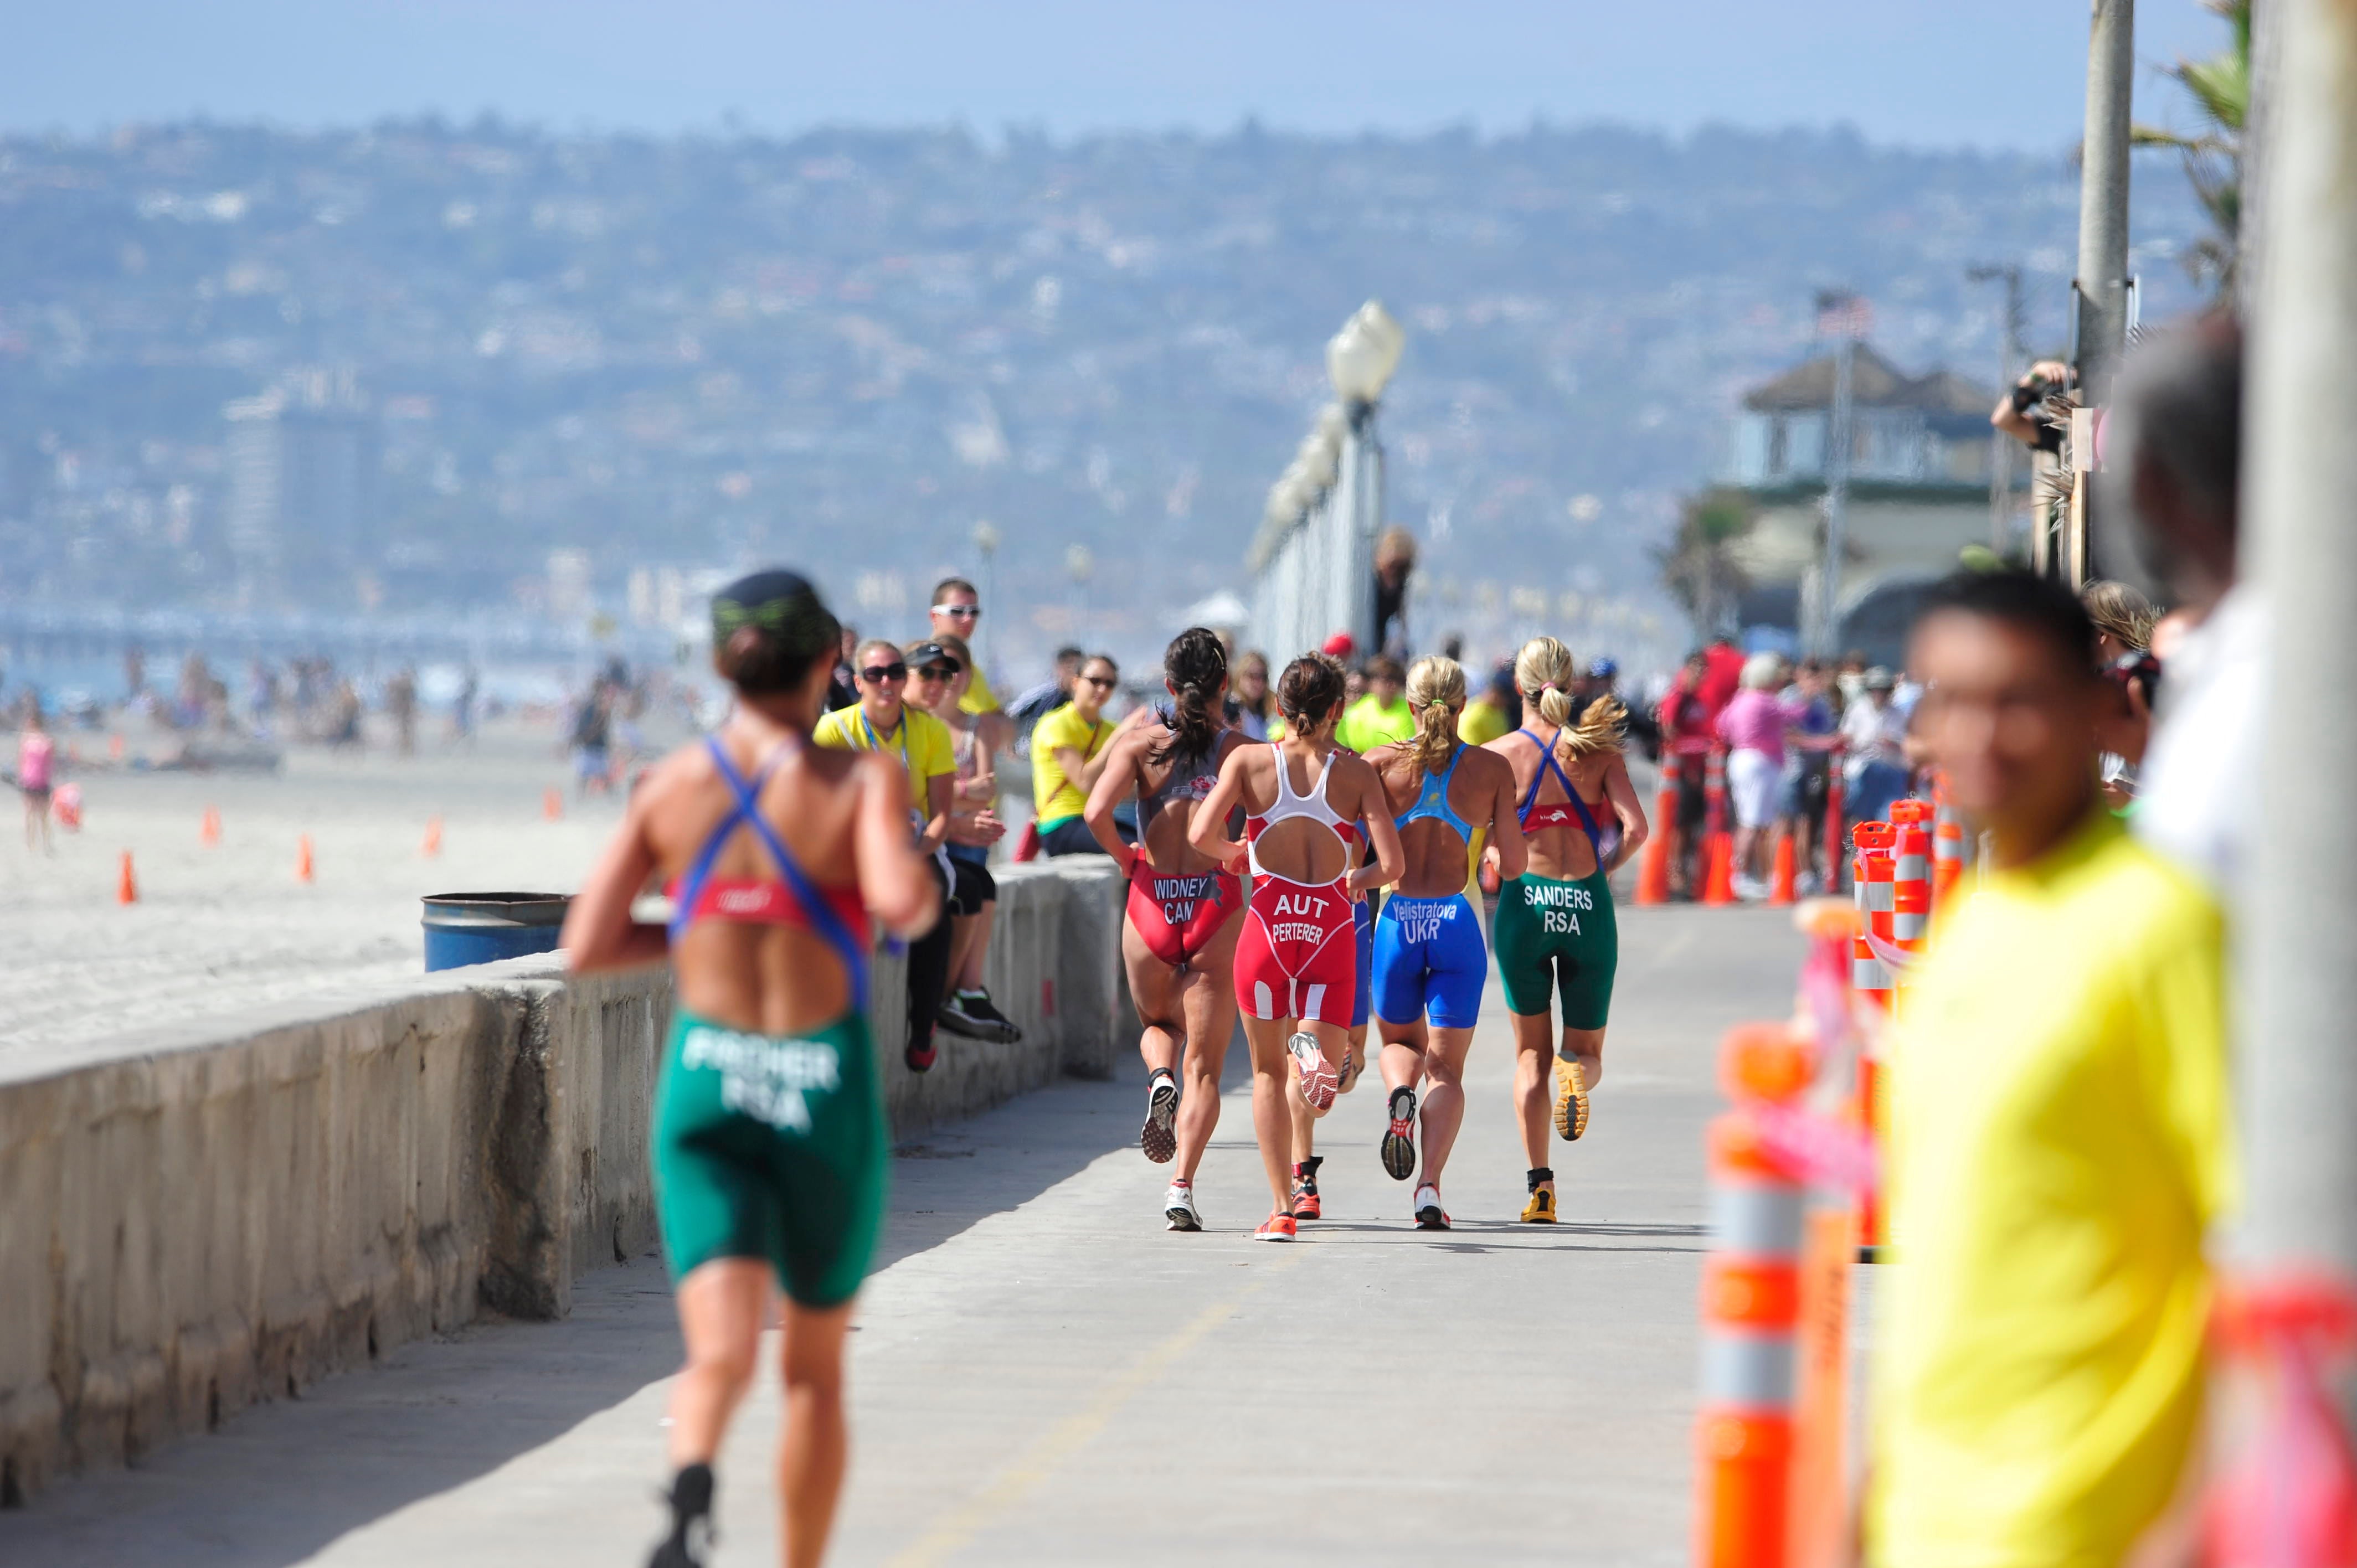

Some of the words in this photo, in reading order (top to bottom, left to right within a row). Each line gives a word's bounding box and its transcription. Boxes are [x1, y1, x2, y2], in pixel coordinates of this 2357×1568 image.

[1154, 877, 1207, 900] WIDNEY
[1525, 885, 1593, 911] SANDERS
[1164, 901, 1193, 925] CAN
[1273, 894, 1329, 919] AUT
[1392, 901, 1457, 921] Yelistratova
[1273, 922, 1323, 945] PERTERER
[1404, 919, 1440, 944] UKR
[1544, 911, 1581, 936] RSA
